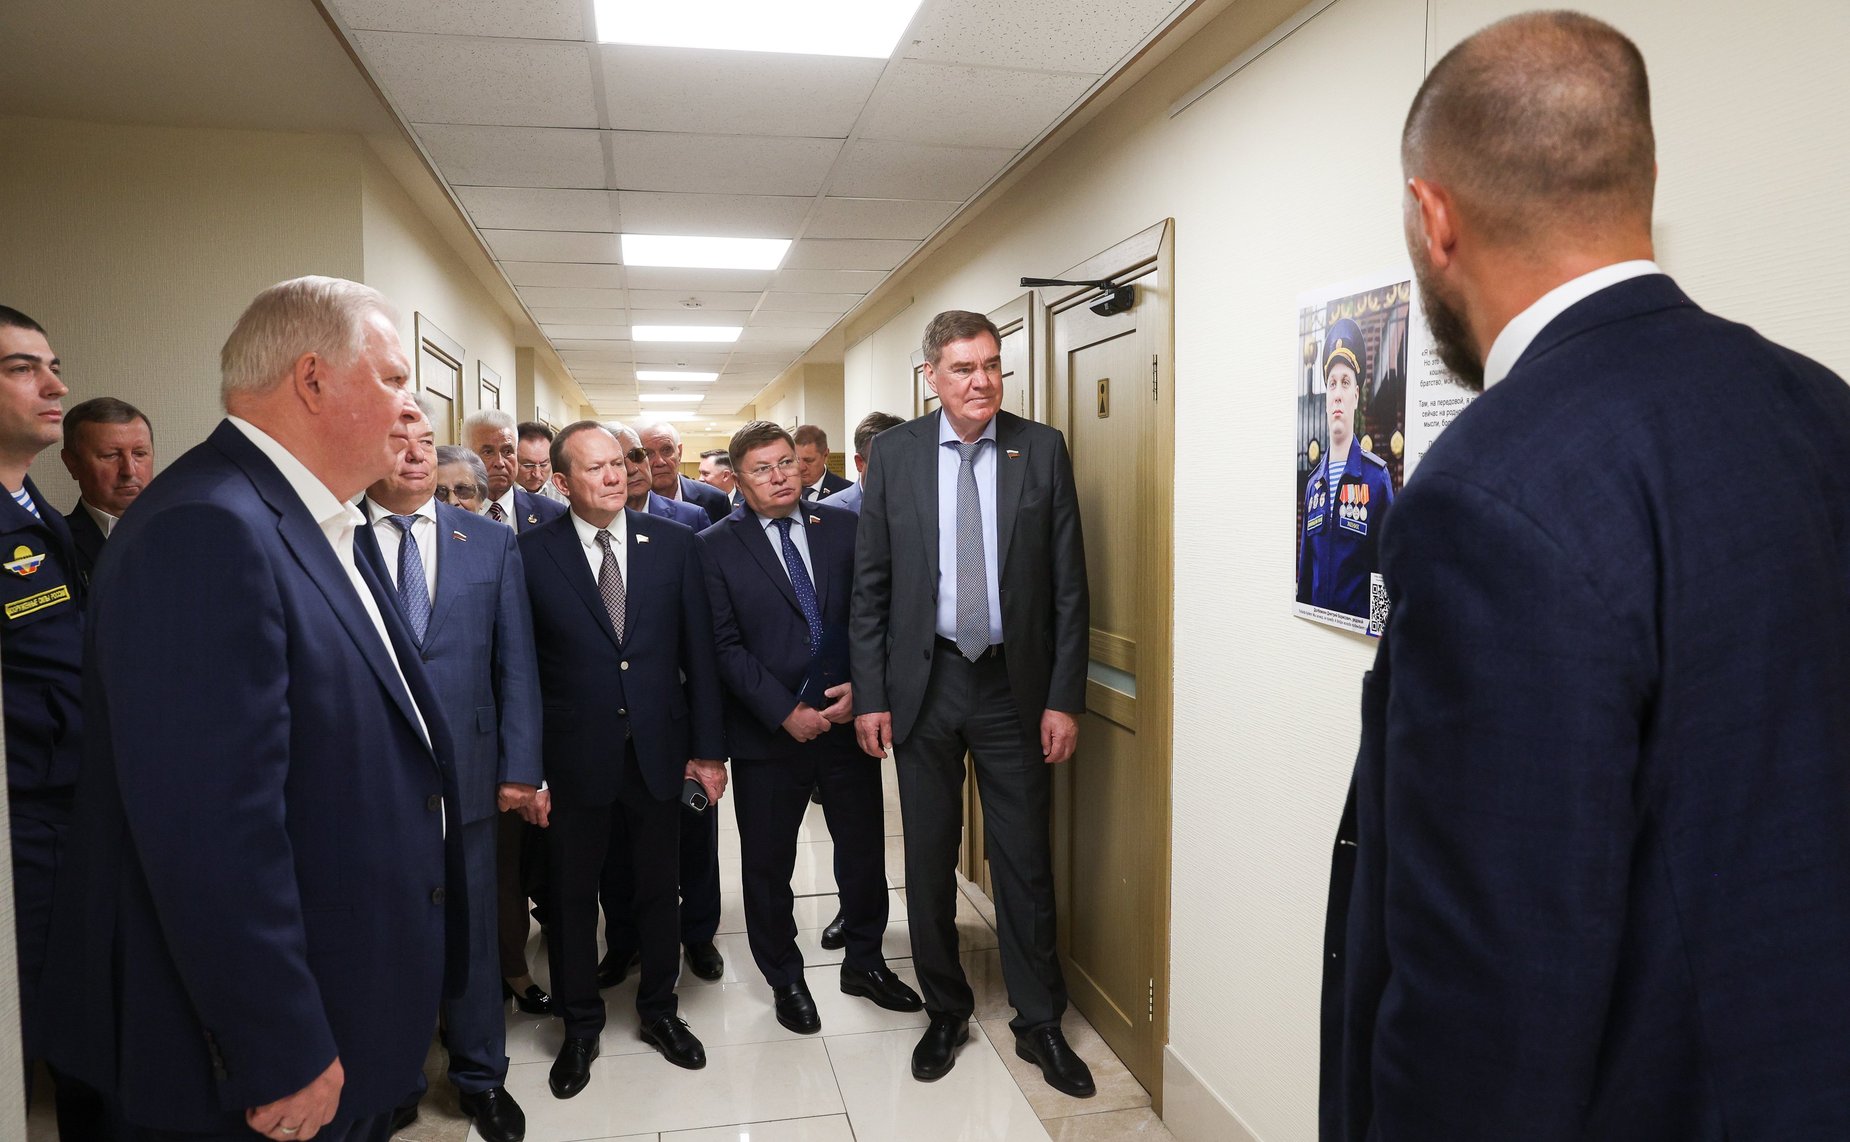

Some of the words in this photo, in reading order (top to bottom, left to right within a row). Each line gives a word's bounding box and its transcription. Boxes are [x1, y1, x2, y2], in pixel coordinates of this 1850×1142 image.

[1423, 359, 1431, 367] Но
[1420, 379, 1442, 388] братство,
[1418, 400, 1429, 408] Там,
[1437, 396, 1465, 408] передовой,
[1421, 409, 1438, 418] сейчас
[1423, 420, 1440, 428] мысли,
